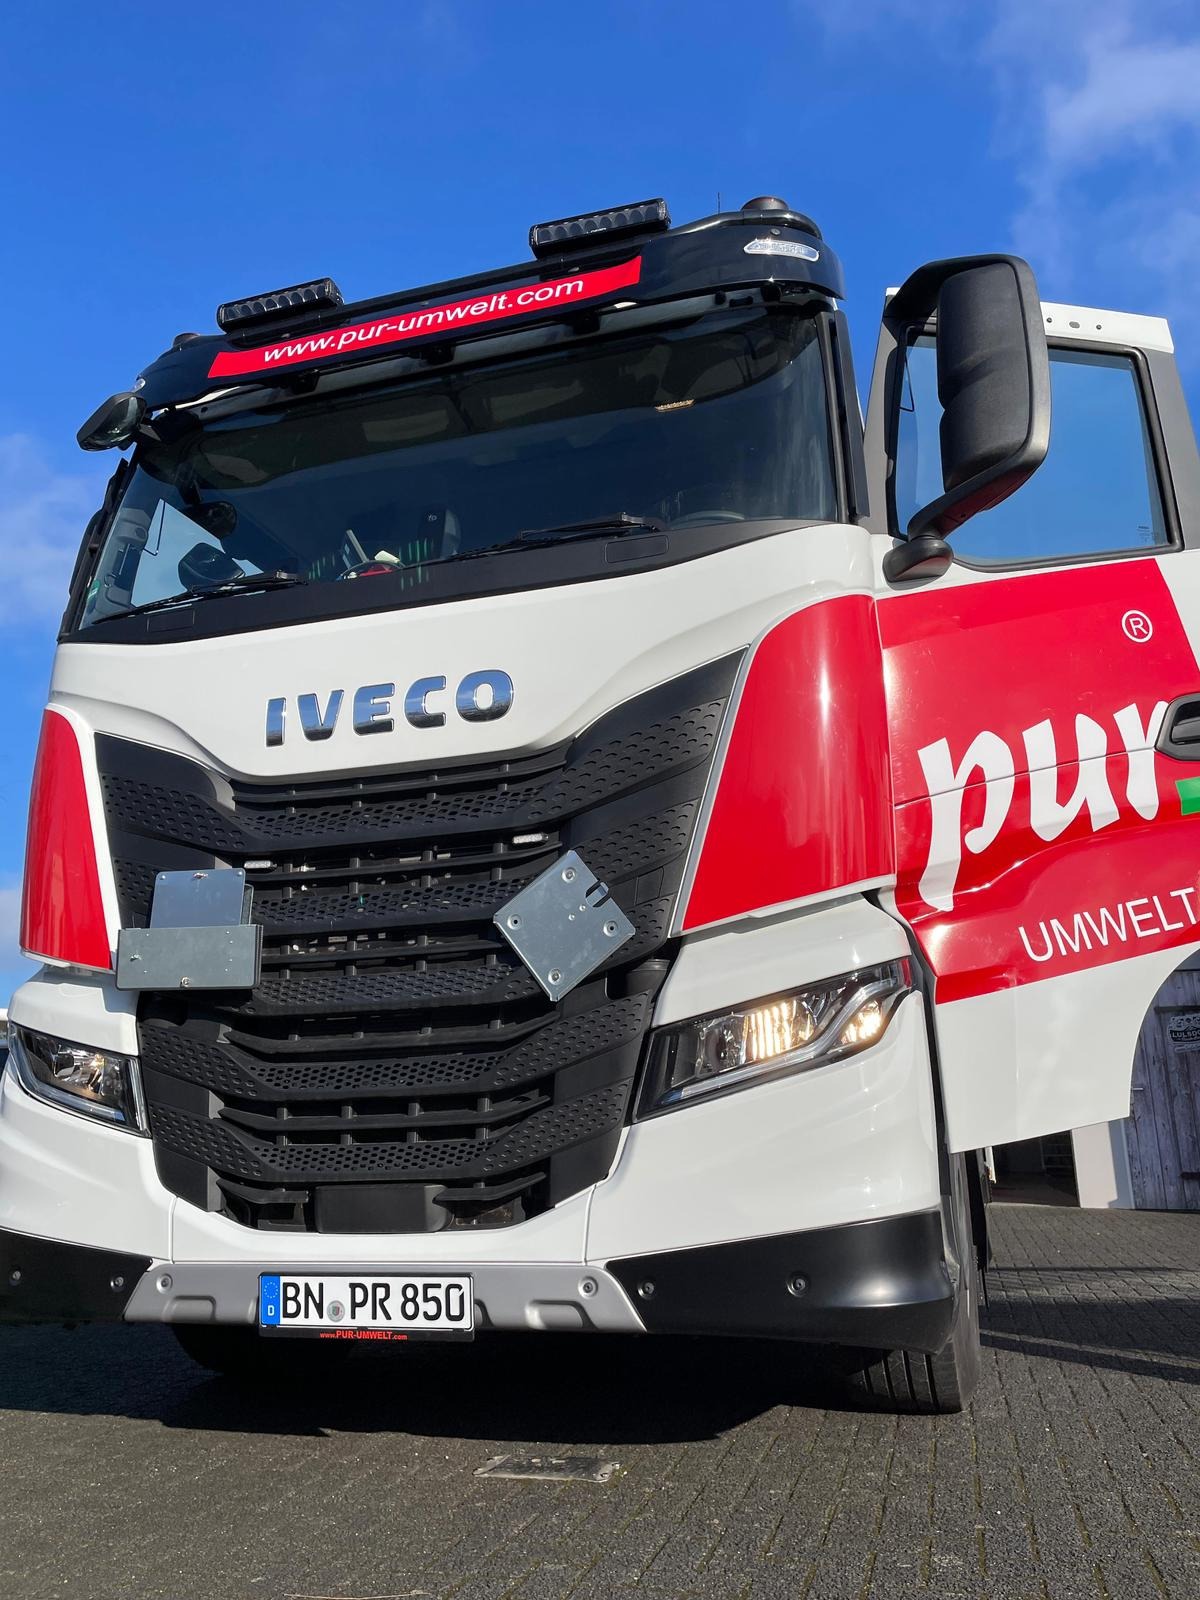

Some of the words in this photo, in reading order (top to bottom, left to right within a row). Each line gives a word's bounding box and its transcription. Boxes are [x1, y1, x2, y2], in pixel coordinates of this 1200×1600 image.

[263, 278, 585, 364] www.pur-umwelt.com
[266, 669, 514, 747] IVECO
[917, 701, 1169, 911] pur
[1019, 887, 1197, 962] UMWELT
[267, 1306, 275, 1316] D
[282, 1282, 324, 1319] BN
[349, 1282, 392, 1321] PR
[400, 1283, 465, 1322] 850
[319, 1330, 408, 1340] www.PUR-UMWELT.com
